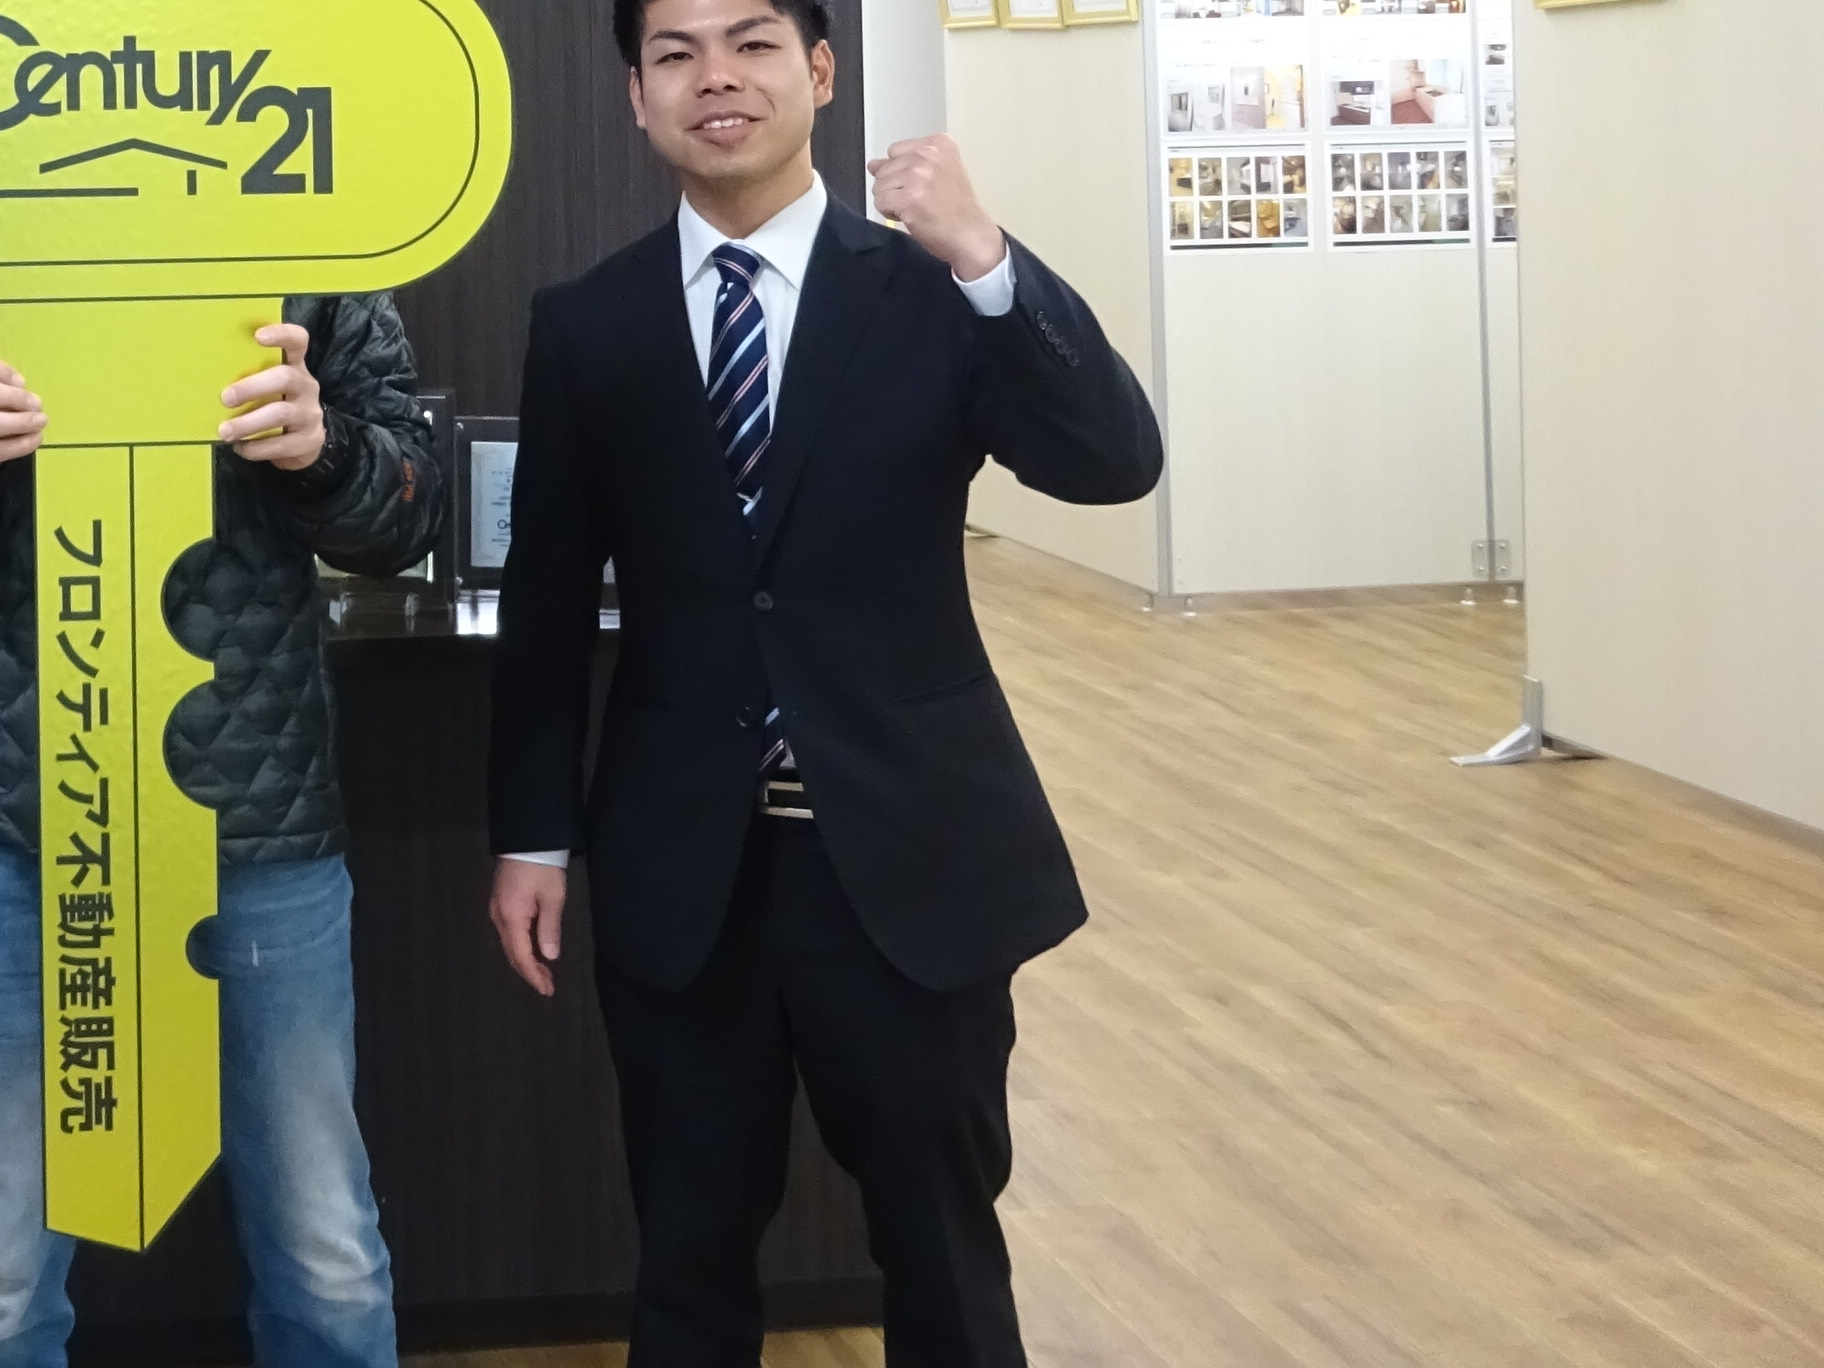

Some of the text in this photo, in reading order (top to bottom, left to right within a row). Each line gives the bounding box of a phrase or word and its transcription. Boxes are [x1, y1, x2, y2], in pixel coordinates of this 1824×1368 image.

[234, 85, 334, 195] 21
[54, 519, 118, 1134] フロンティア不動産販売
